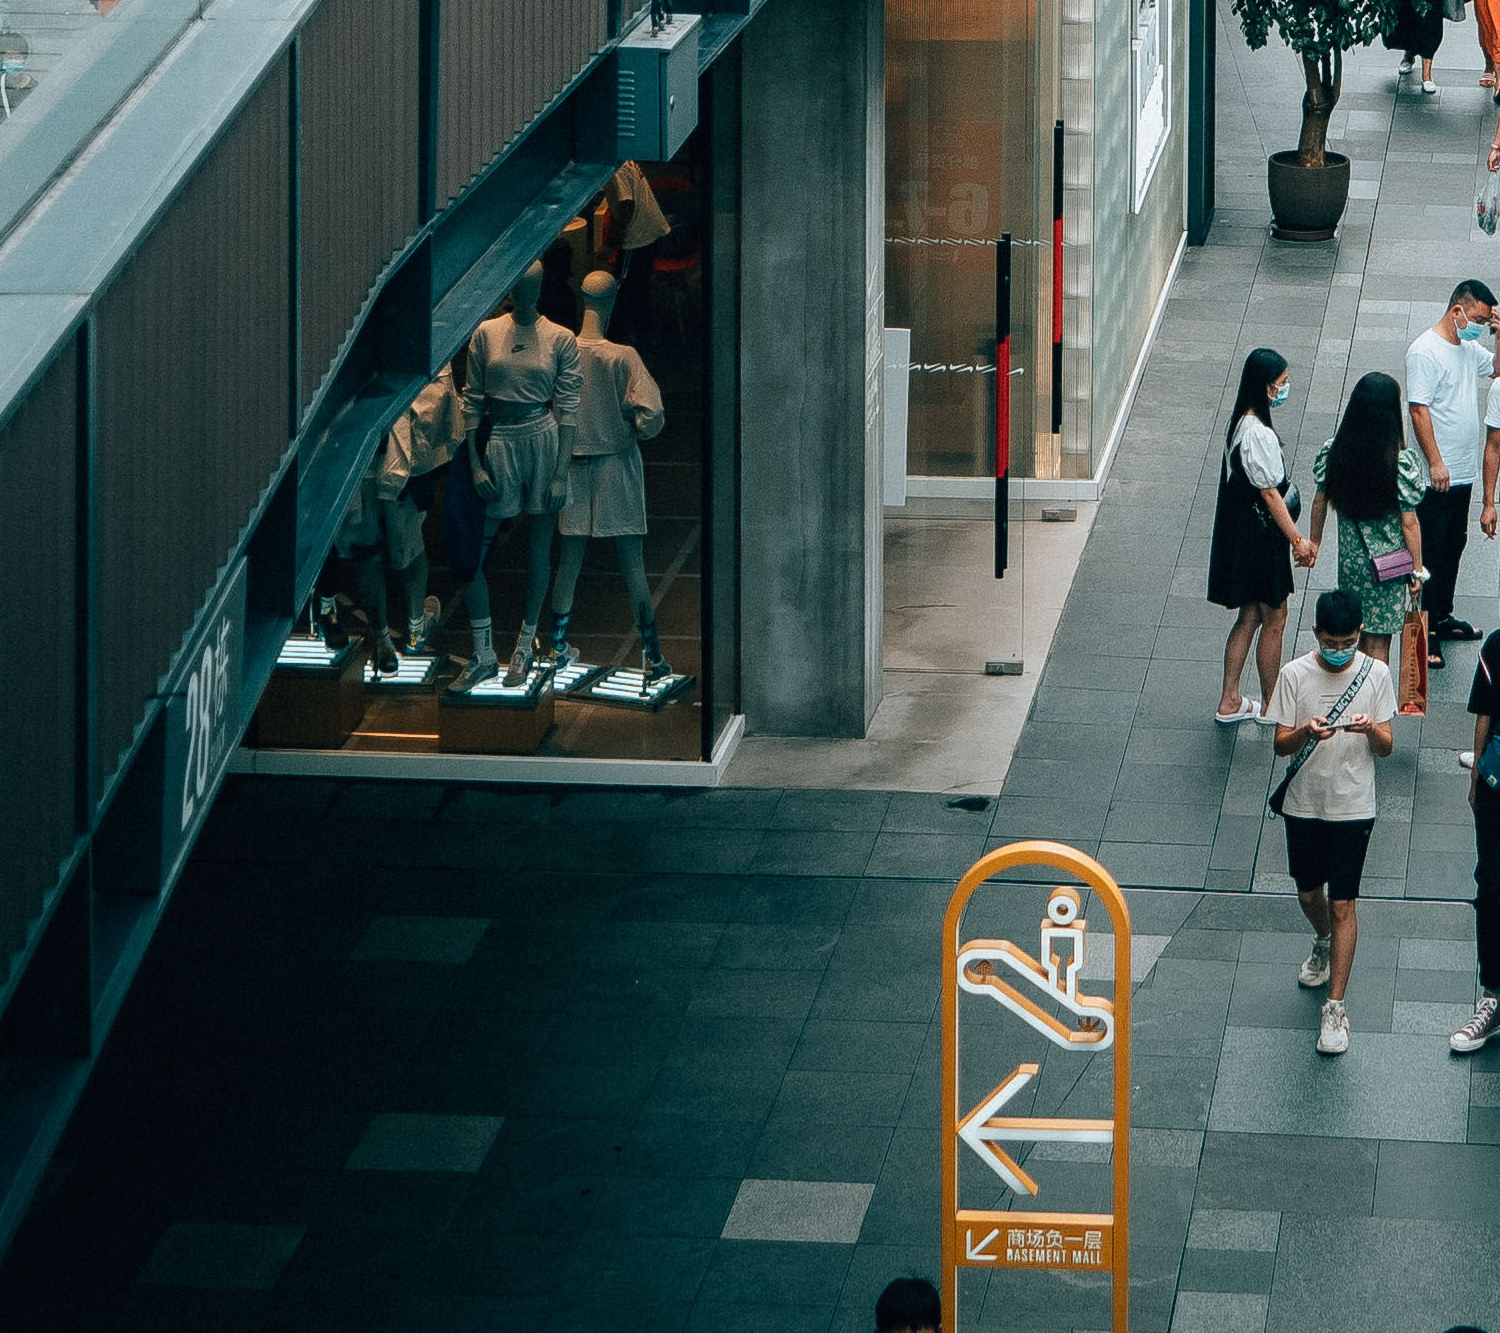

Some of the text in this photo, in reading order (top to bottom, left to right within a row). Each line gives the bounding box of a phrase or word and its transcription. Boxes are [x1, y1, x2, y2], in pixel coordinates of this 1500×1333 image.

[1006, 1230, 1102, 1248] 商场负一层
[1006, 1248, 1102, 1265] BASEMENT MALL
